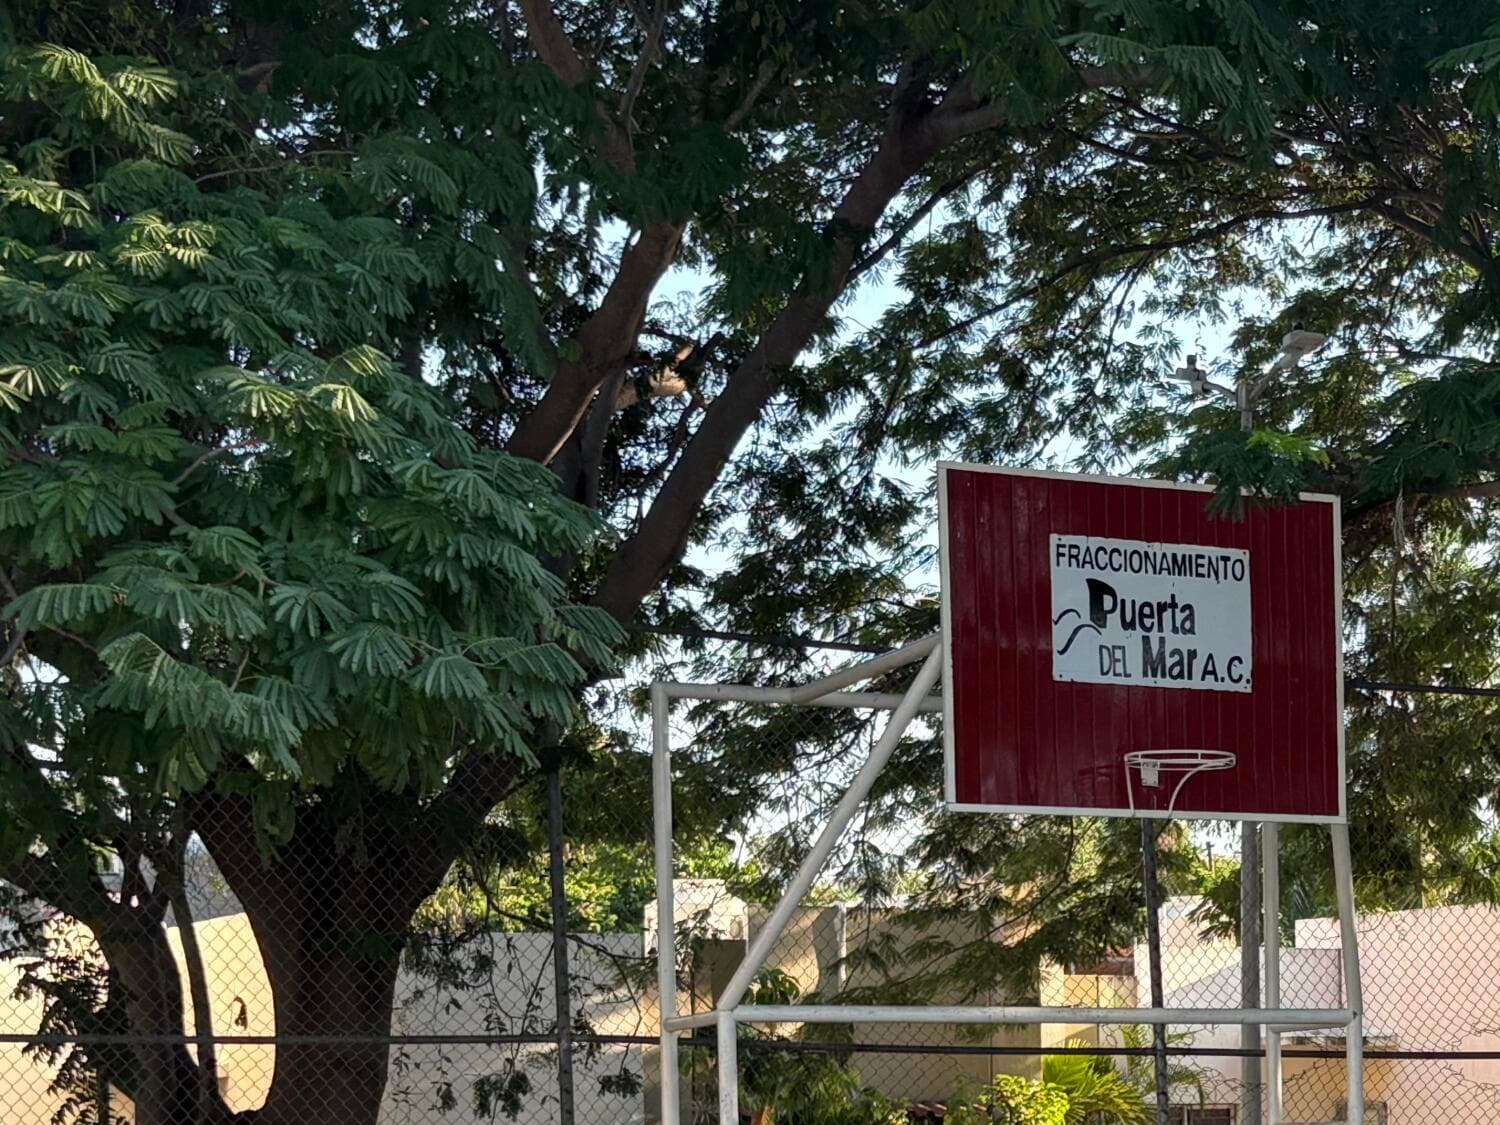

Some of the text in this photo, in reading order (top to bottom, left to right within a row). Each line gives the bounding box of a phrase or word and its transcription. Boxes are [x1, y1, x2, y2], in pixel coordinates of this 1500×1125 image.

[1056, 543, 1245, 581] FRACCIONAMIENTO
[1086, 578, 1196, 635] Puerta
[1099, 635, 1250, 684] DEL Mar A.C.
